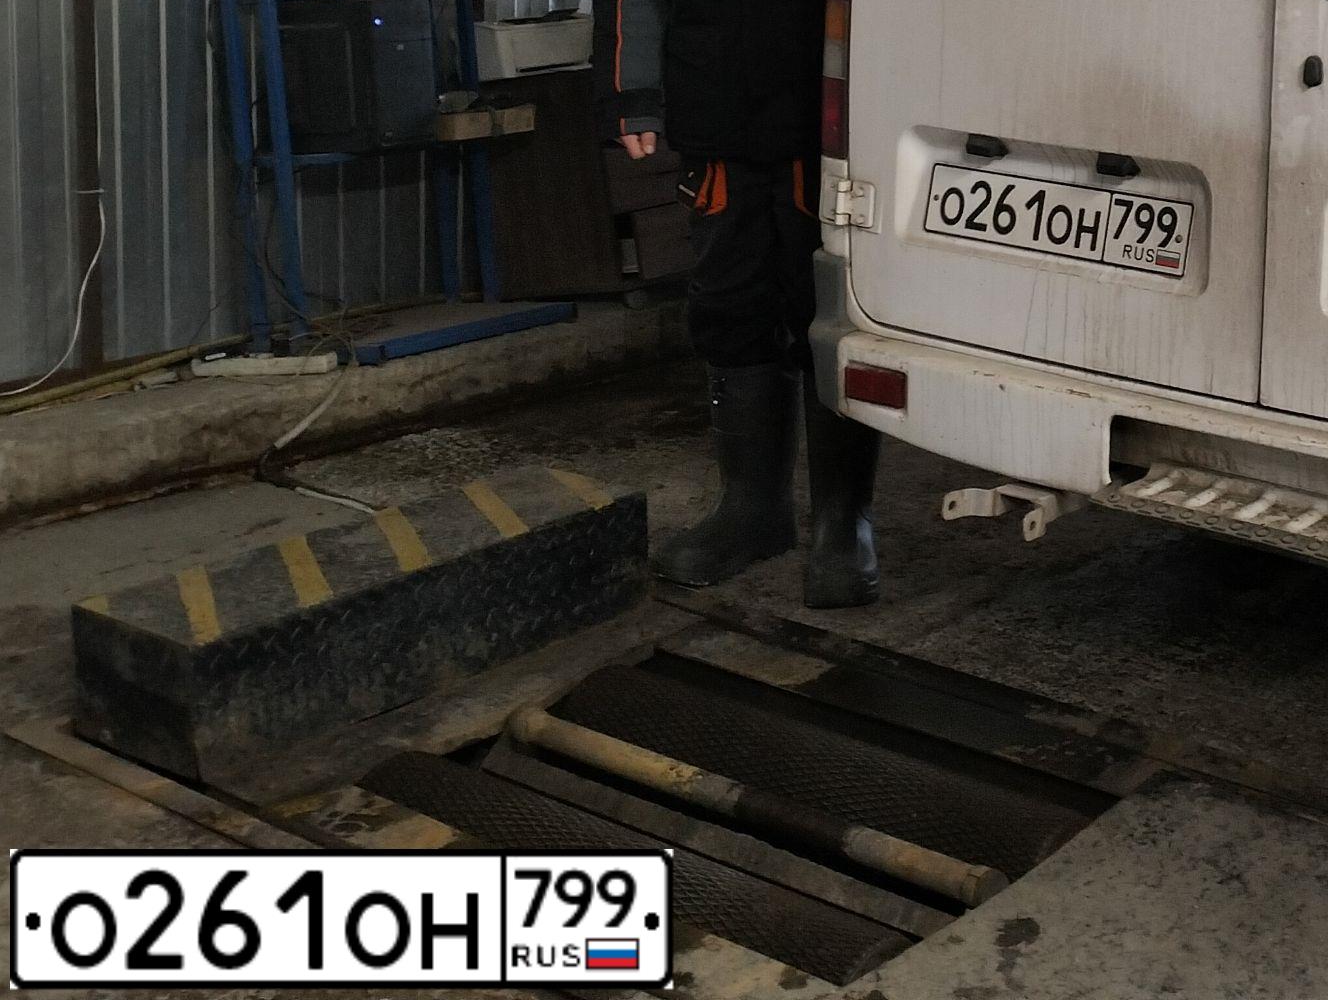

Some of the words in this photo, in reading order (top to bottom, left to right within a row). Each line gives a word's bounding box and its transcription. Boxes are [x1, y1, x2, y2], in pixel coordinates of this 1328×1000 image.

[939, 180, 1101, 252] O261OH
[1113, 198, 1178, 249] 799
[1121, 244, 1154, 263] RUS
